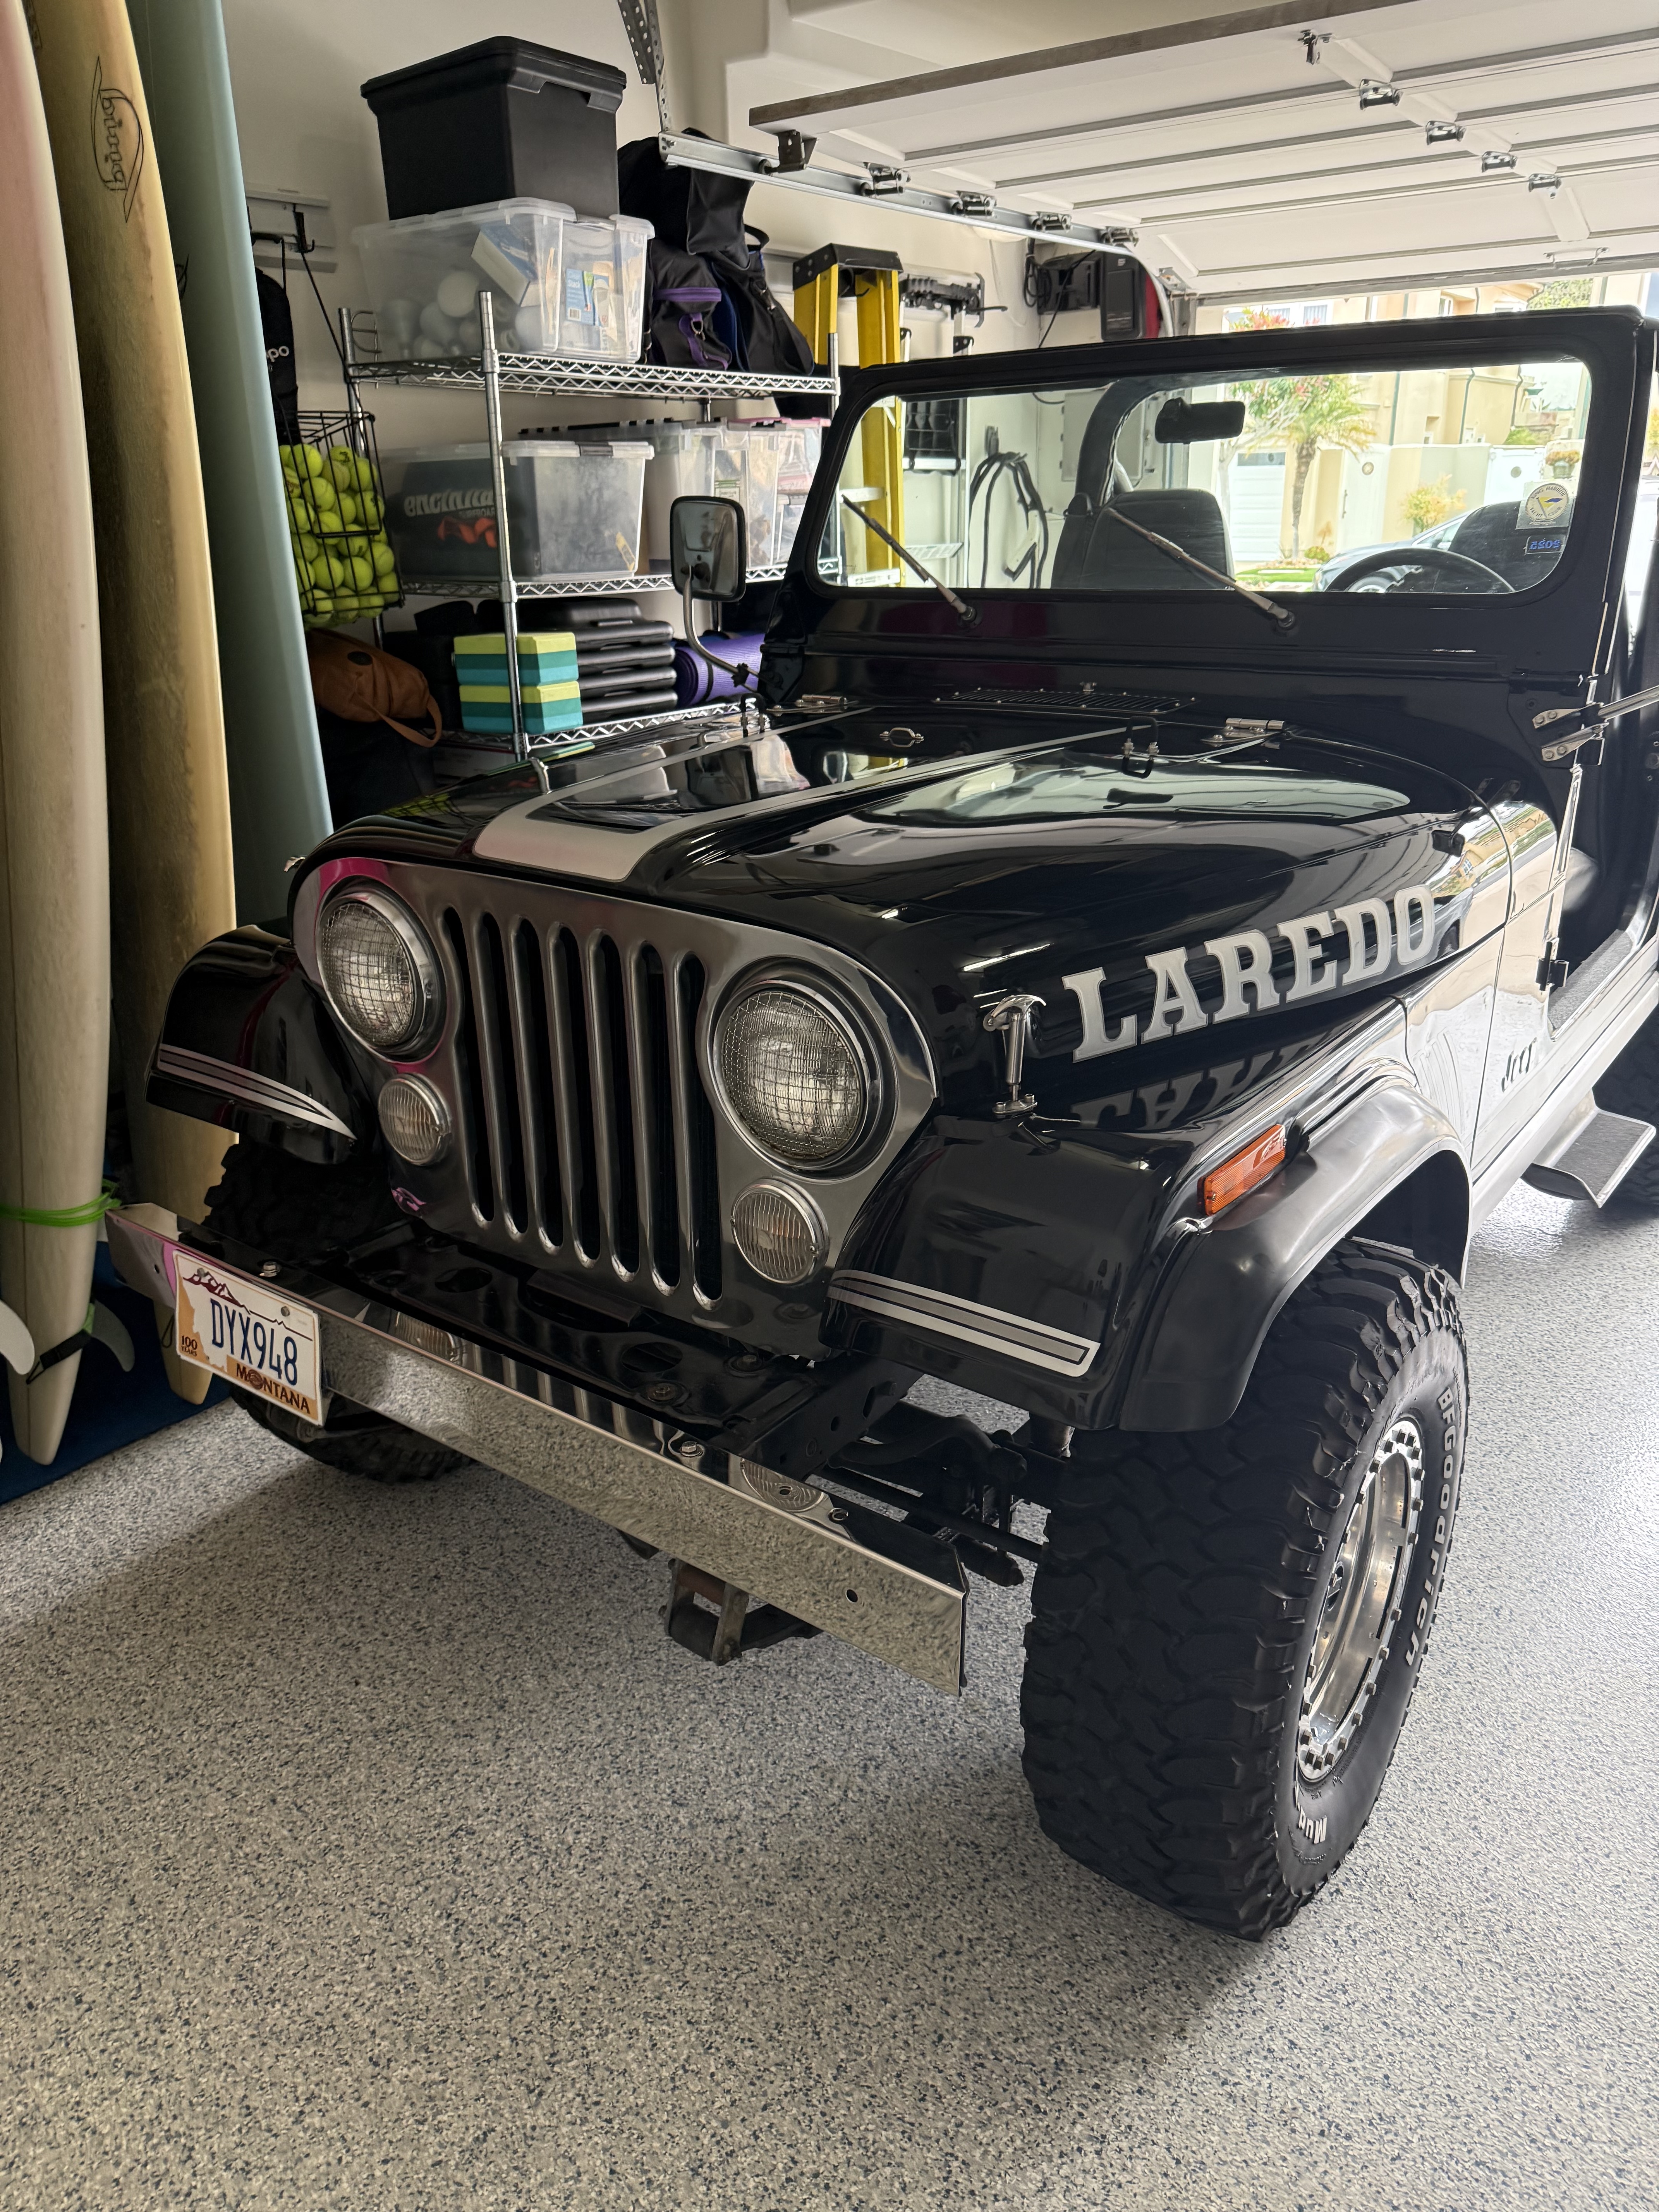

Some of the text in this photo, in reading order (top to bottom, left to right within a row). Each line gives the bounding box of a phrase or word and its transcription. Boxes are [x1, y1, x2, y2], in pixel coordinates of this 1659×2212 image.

[266, 345, 290, 362] po
[1061, 884, 1434, 1063] LAREDO
[181, 1345, 198, 1357] YEARS
[182, 1335, 198, 1350] 100
[210, 1298, 297, 1386] DYX948
[236, 1363, 311, 1414] MONTANA
[1406, 1387, 1456, 1666] BFGoodrich
